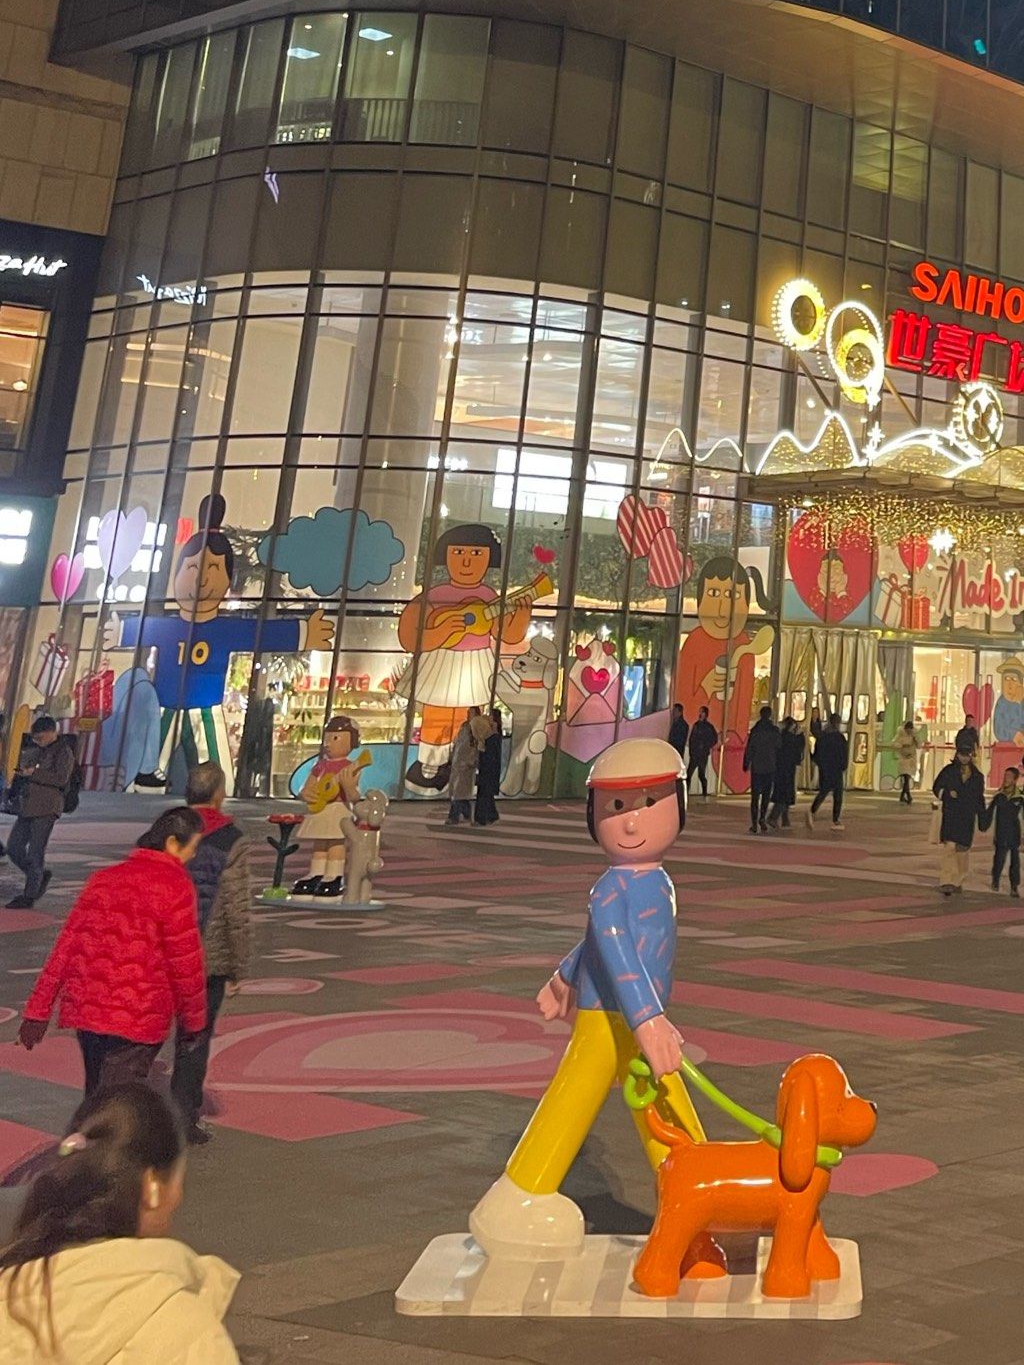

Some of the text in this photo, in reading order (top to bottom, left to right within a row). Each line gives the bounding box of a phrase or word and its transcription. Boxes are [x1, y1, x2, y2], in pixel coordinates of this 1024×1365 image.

[23, 255, 68, 276] Hut
[937, 559, 1005, 614] Made
[178, 641, 209, 665] 10
